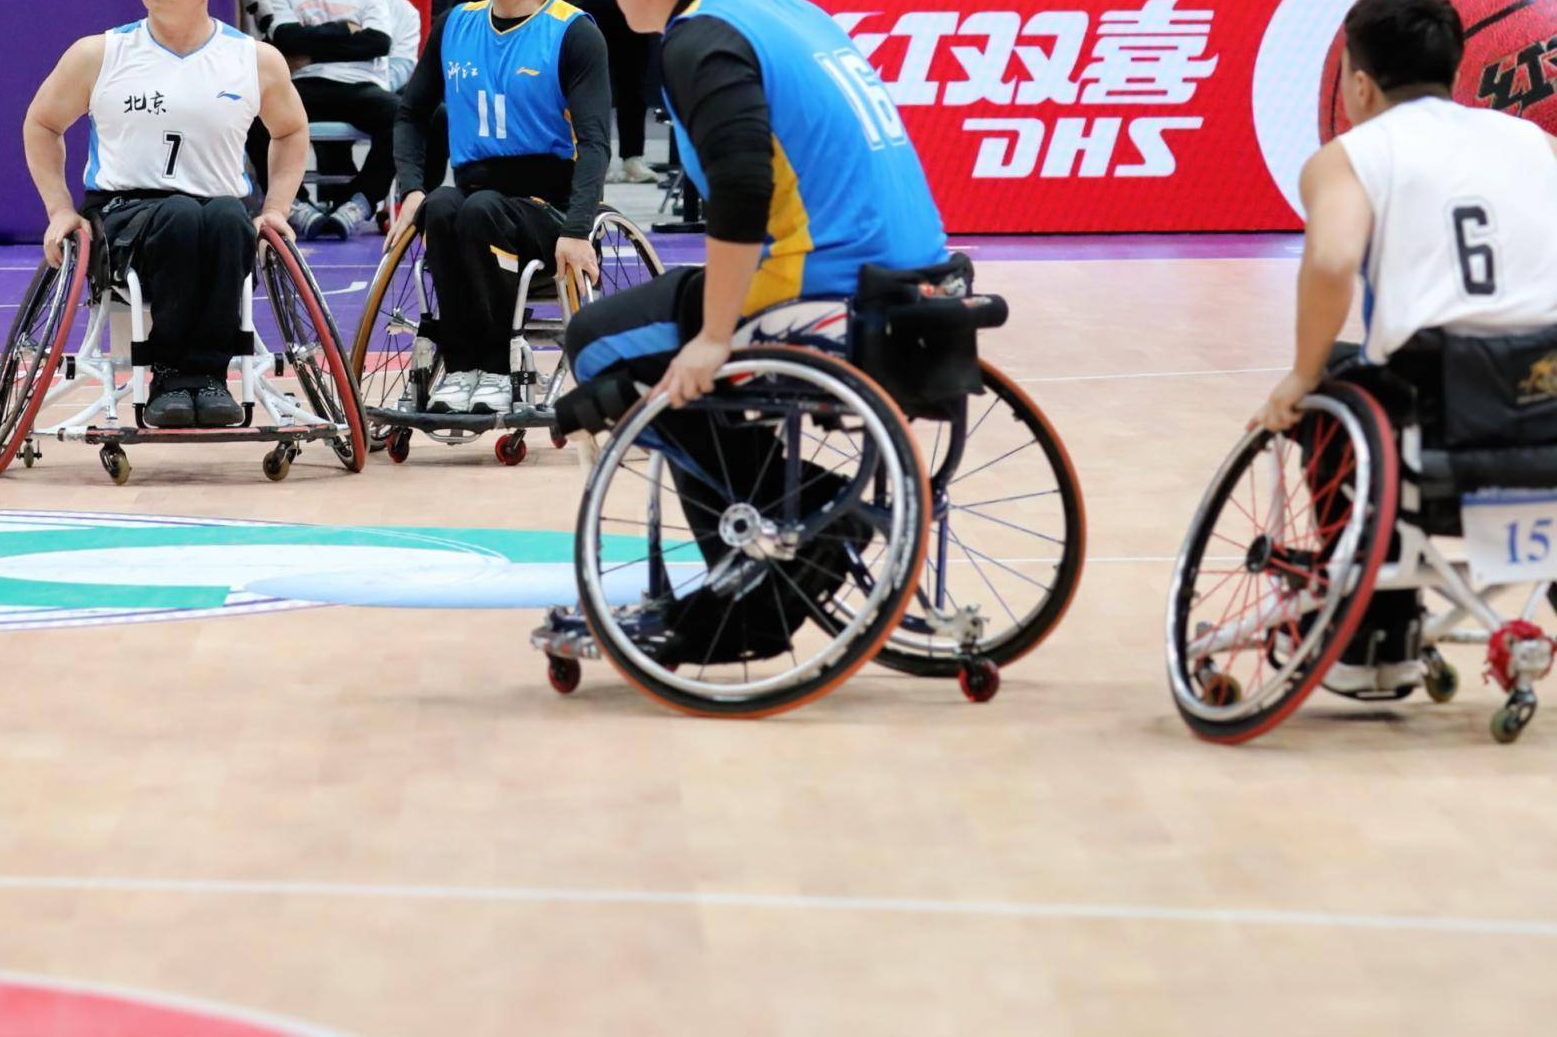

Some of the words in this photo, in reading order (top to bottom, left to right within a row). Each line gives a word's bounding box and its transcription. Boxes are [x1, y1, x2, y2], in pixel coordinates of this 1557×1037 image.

[123, 91, 167, 115] 北京
[477, 89, 507, 139] 11
[163, 131, 183, 179] 7
[962, 117, 1204, 179] DHS
[1447, 201, 1500, 300] 6
[1505, 518, 1552, 565] 15
